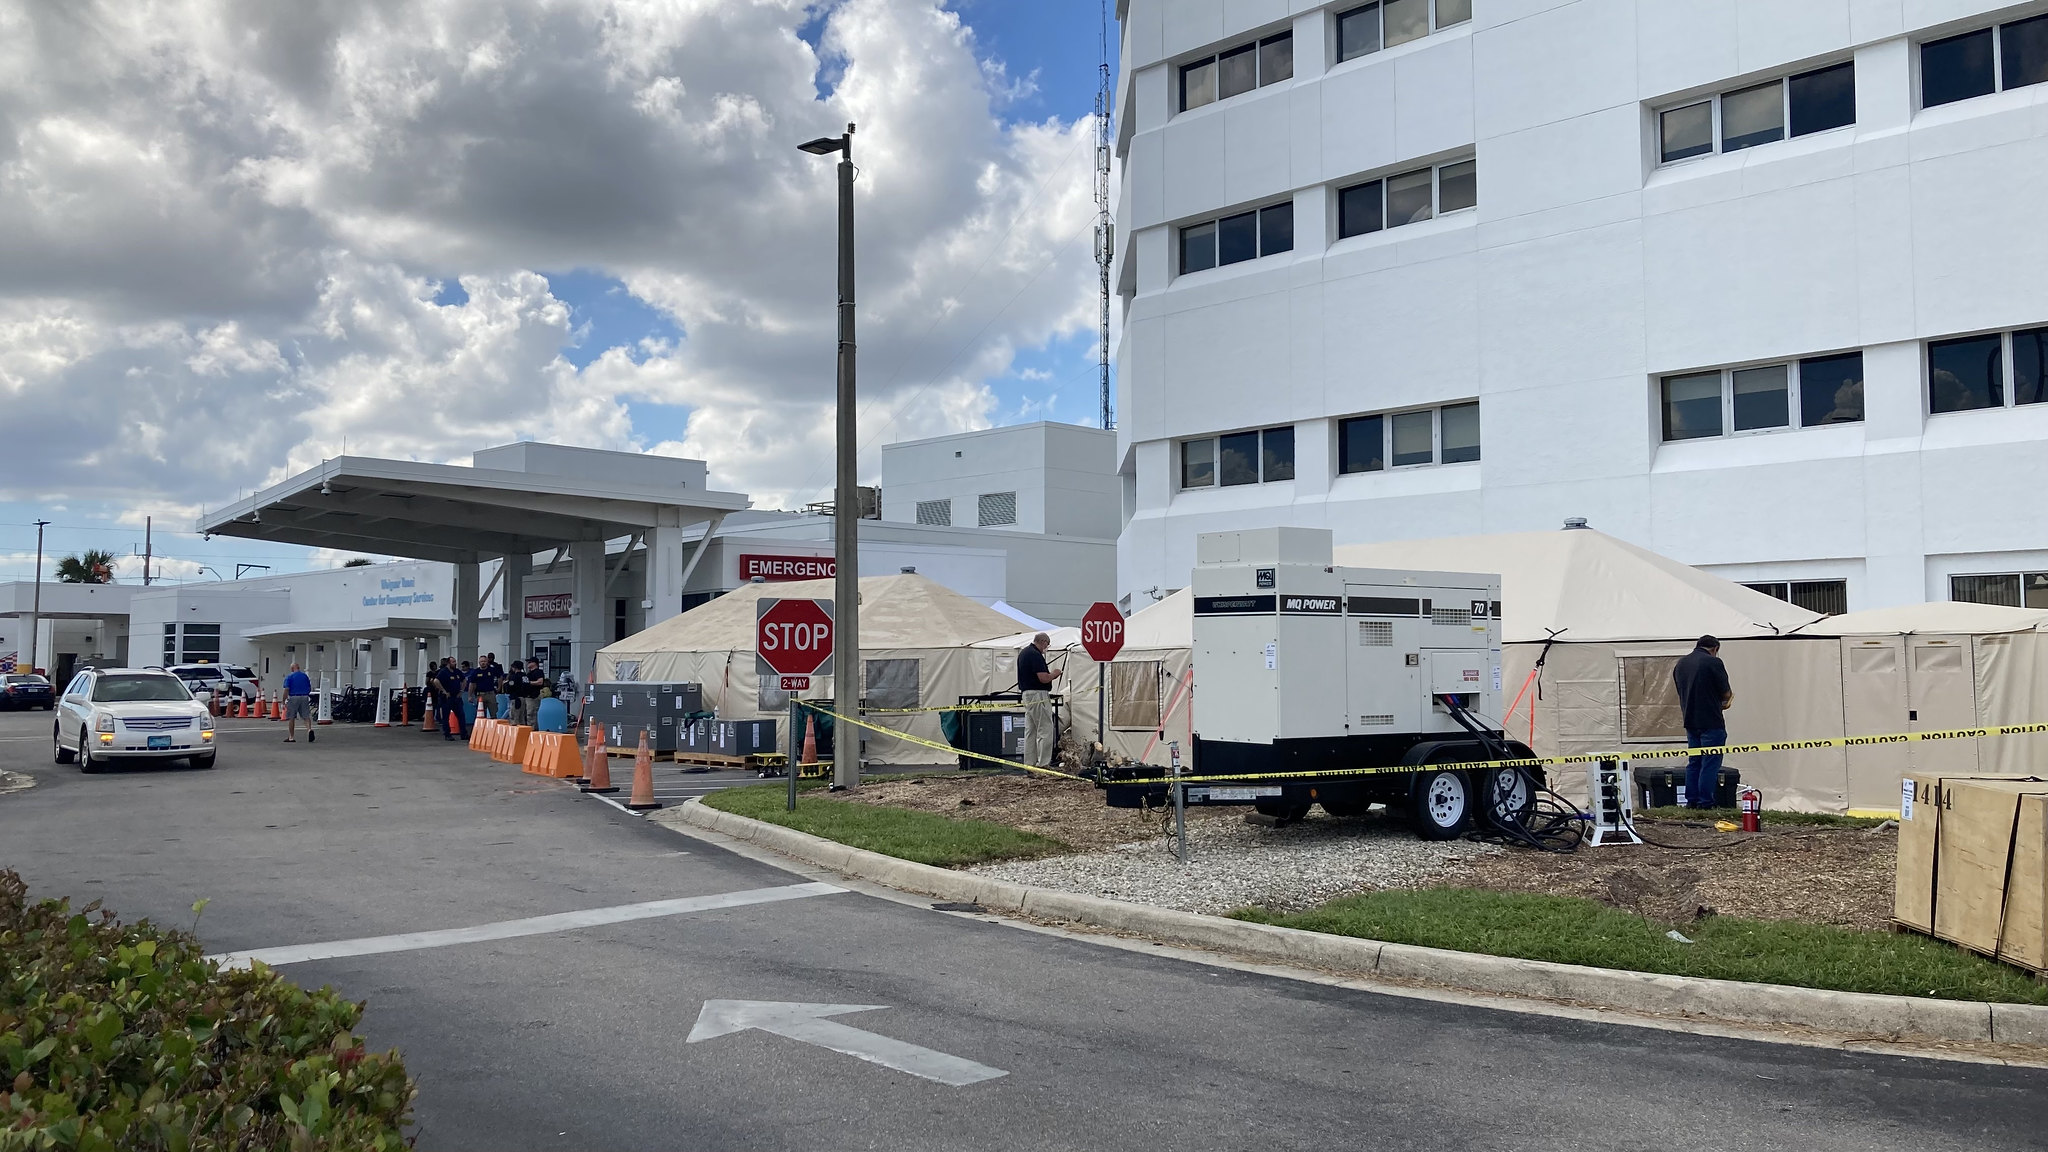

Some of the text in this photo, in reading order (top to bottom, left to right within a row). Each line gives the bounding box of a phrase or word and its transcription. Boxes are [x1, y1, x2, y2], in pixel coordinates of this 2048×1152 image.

[749, 560, 836, 577] EMERGENC
[1257, 570, 1273, 581] MQ
[527, 598, 574, 613] EMERGENC
[1286, 598, 1336, 611] MQ POWER
[1473, 602, 1485, 614] 70
[763, 622, 829, 651] STOP
[1084, 620, 1122, 643] STOP
[782, 678, 807, 688] 2-WAY
[1921, 729, 1987, 741] CAUTION
[2000, 724, 2048, 735] UTION
[1771, 740, 1833, 751] CAUTION
[1845, 735, 1908, 746] CAUTION
[1632, 750, 1689, 760] CAUTION
[1700, 745, 1759, 756] CAUTION
